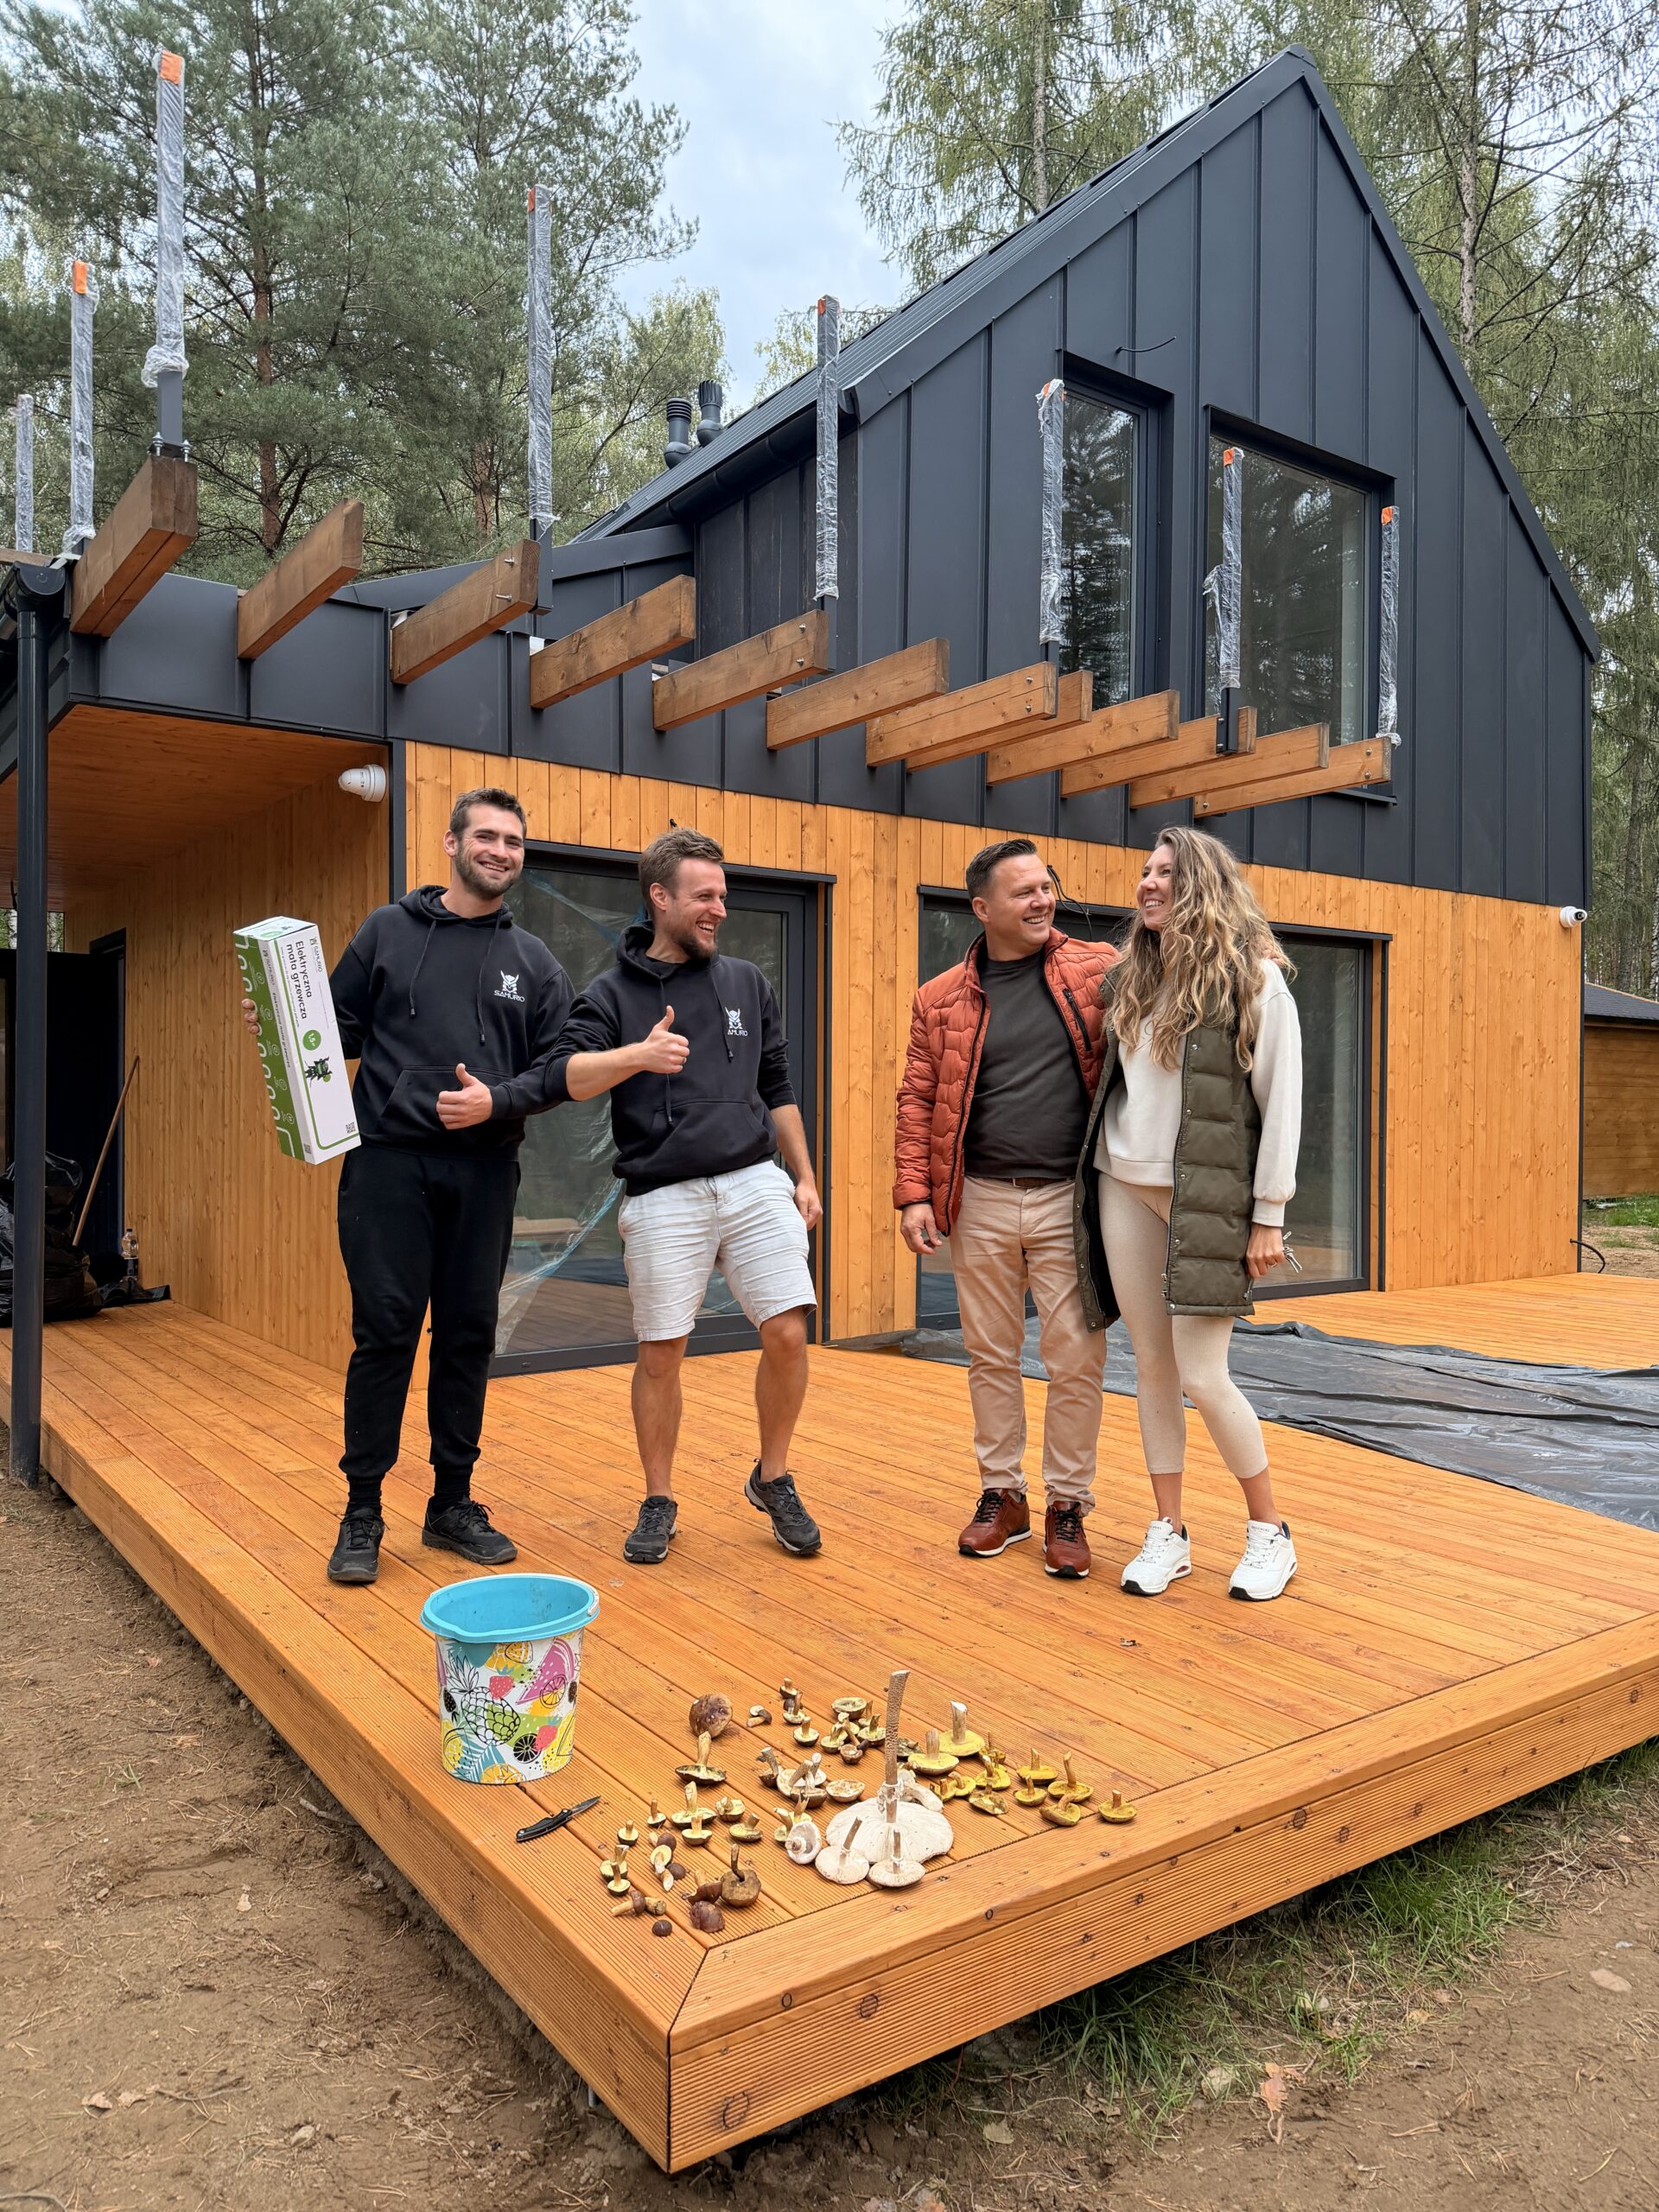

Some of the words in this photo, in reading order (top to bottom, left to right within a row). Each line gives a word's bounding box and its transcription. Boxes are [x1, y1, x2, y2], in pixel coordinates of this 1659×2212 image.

[286, 944, 297, 970] mata
[296, 940, 312, 998] Elektryczna
[290, 972, 307, 1020] grzewcza
